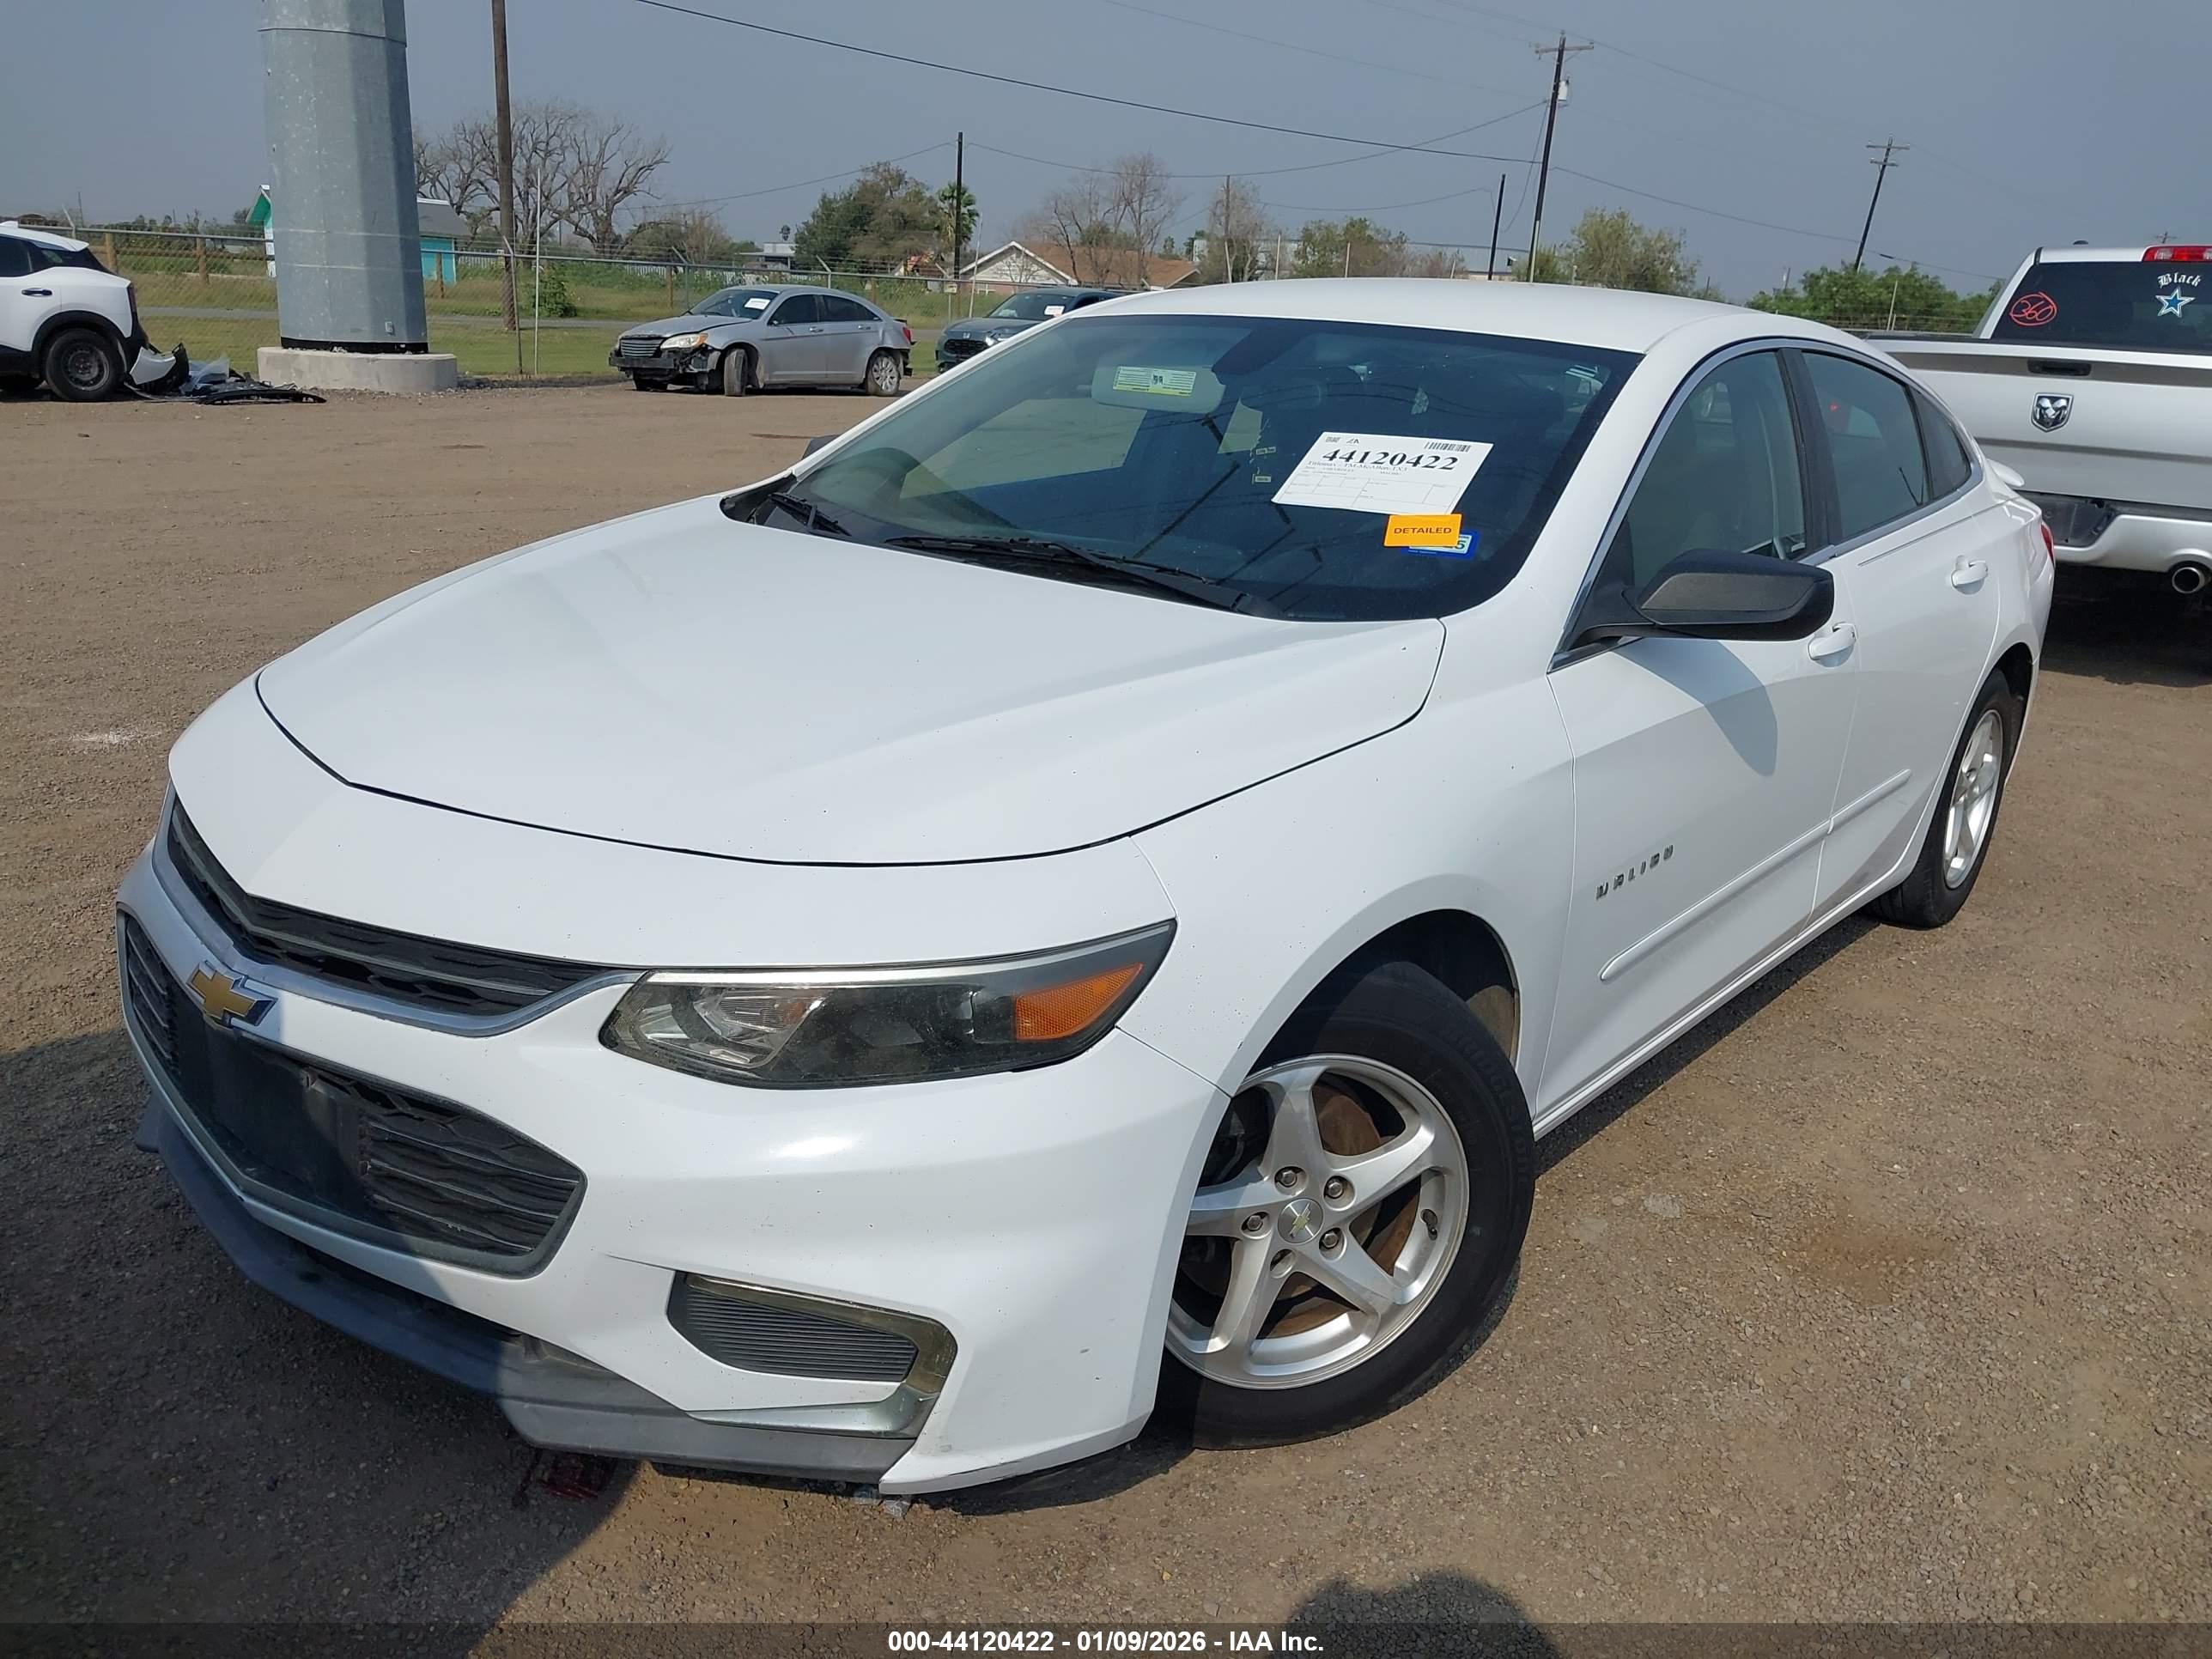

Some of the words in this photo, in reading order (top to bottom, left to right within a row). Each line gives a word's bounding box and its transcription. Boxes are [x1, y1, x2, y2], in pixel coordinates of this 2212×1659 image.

[2157, 271, 2202, 289] Black
[2015, 300, 2053, 321] 360
[1322, 448, 1459, 471] 44120422
